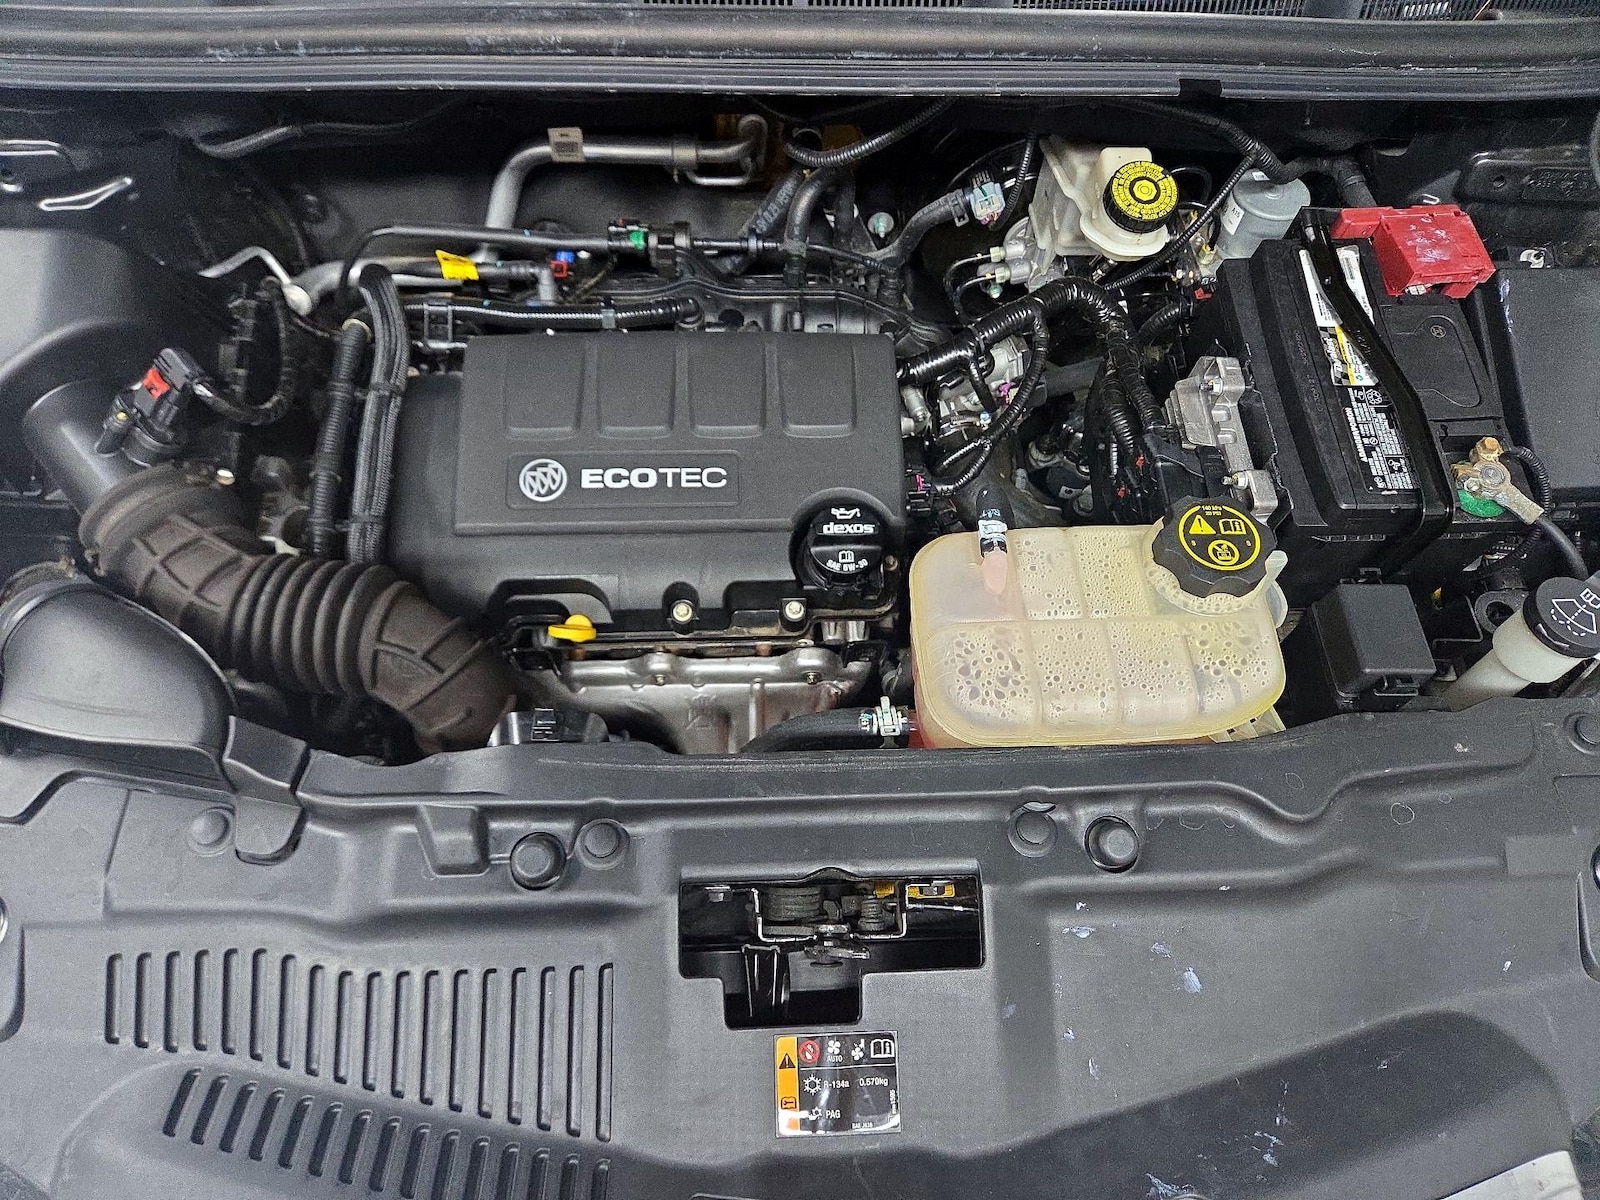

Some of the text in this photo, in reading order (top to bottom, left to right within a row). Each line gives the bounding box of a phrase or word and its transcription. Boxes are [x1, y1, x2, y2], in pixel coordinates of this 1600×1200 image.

[580, 467, 728, 489] ECOTEC
[822, 521, 875, 534] dexos
[826, 559, 841, 571] SAE
[826, 1055, 843, 1063] AUTO
[823, 1080, 850, 1089] R-134a
[825, 1110, 841, 1119] PAG
